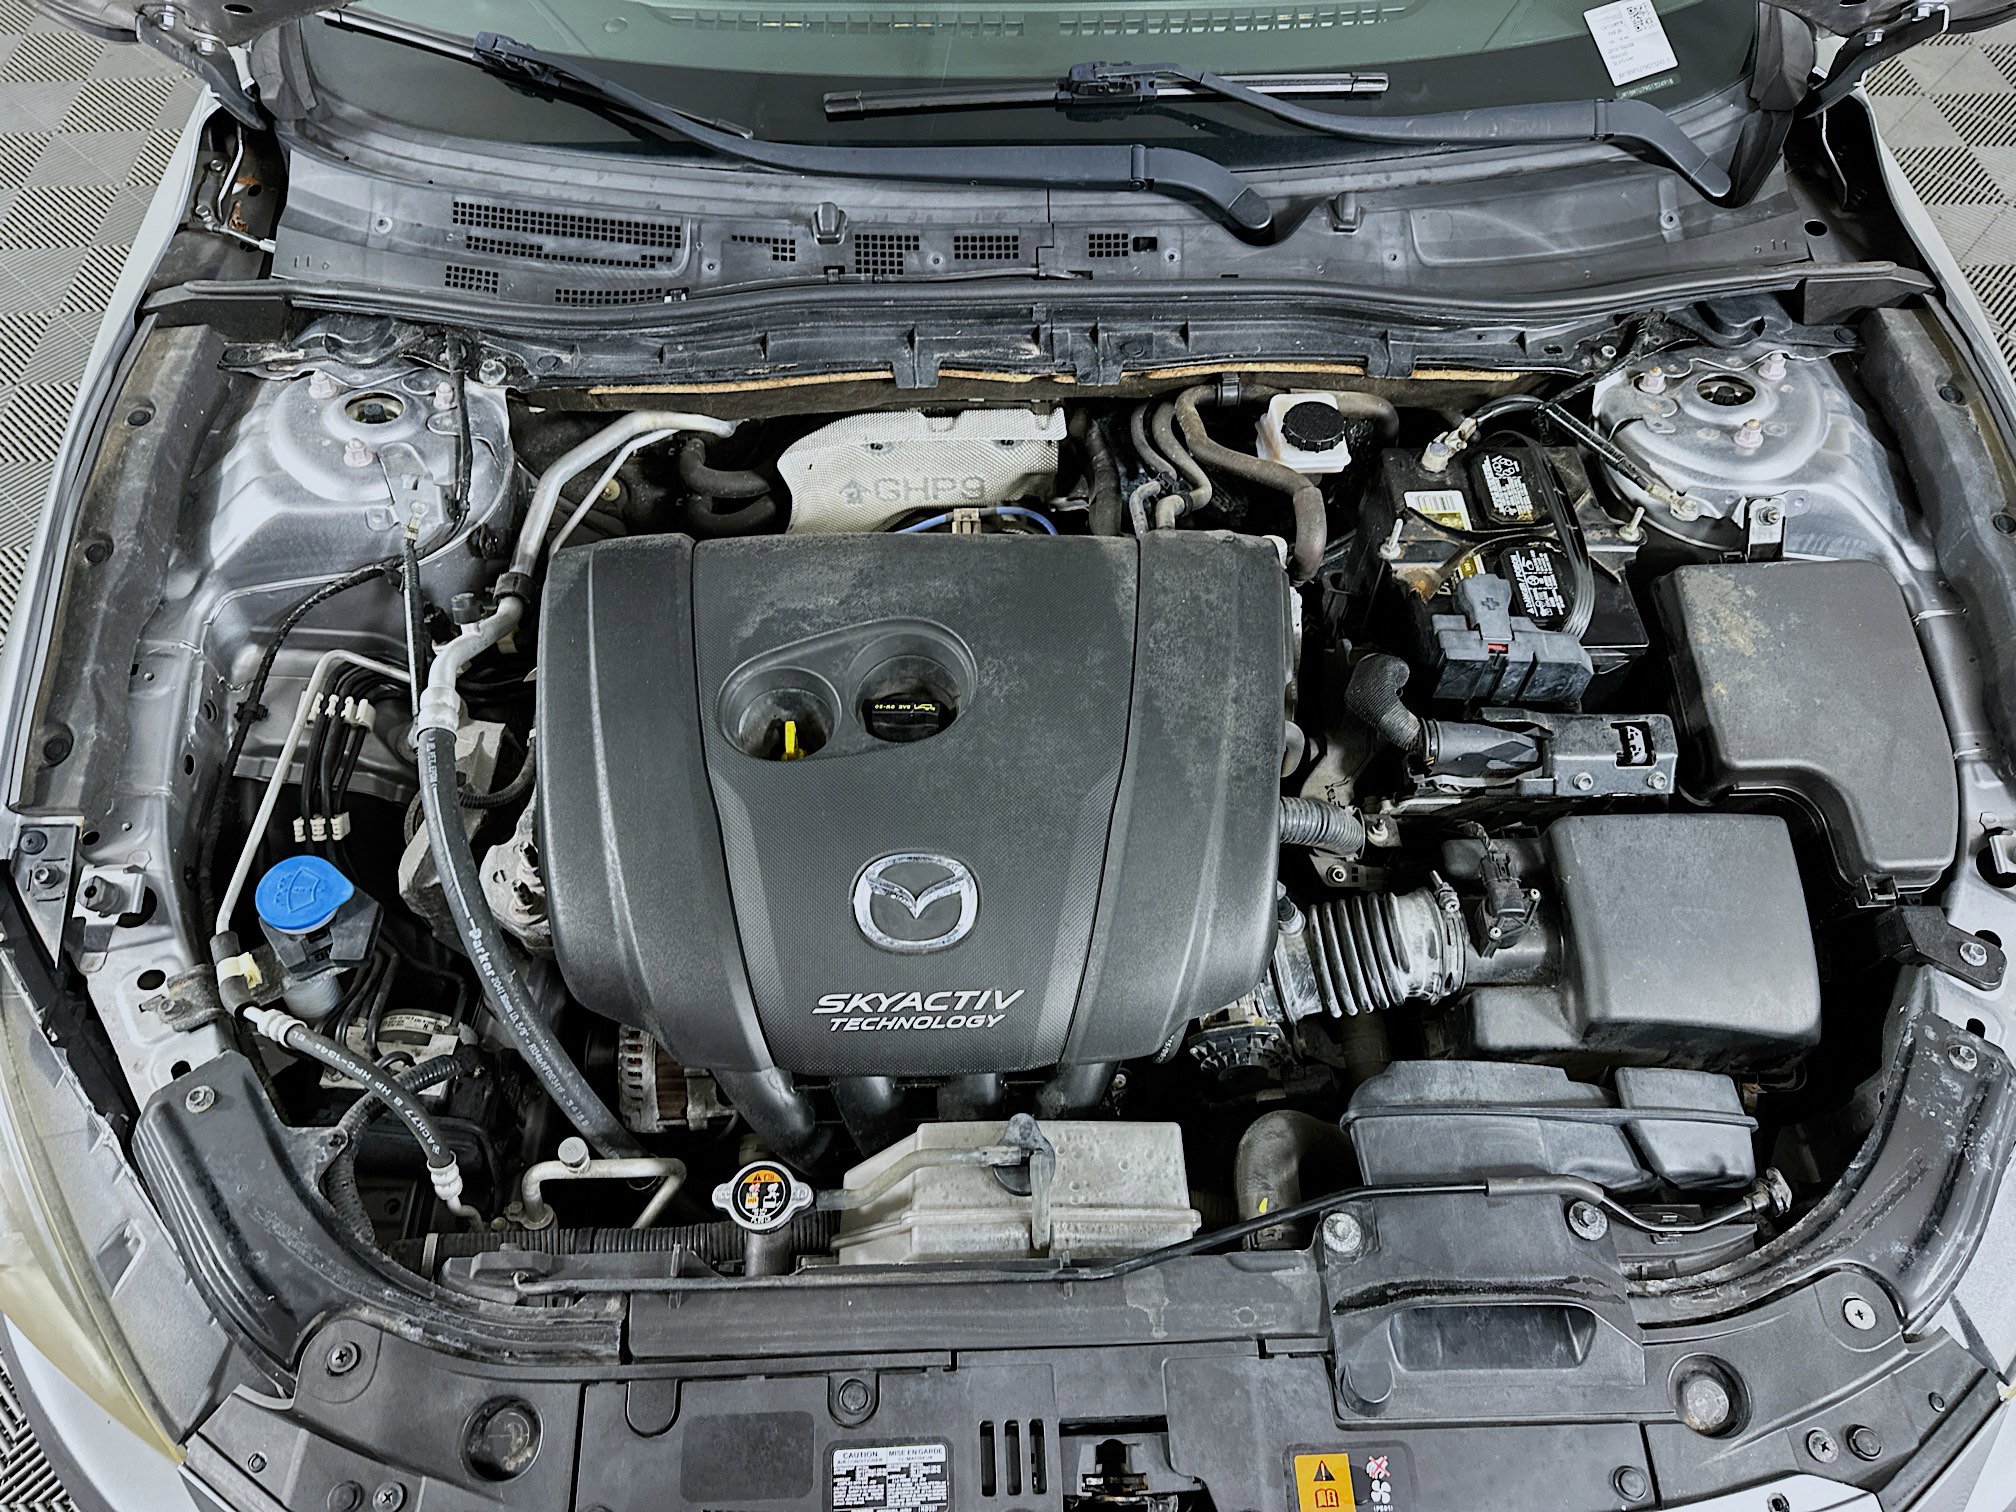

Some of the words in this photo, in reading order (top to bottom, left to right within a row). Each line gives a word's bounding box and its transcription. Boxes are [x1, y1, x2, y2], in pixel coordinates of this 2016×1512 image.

[874, 476, 985, 500] GHP9
[467, 927, 496, 978] Parker
[812, 989, 1025, 1014] SKYACTIV
[830, 1014, 1006, 1032] TECHNOLOGY
